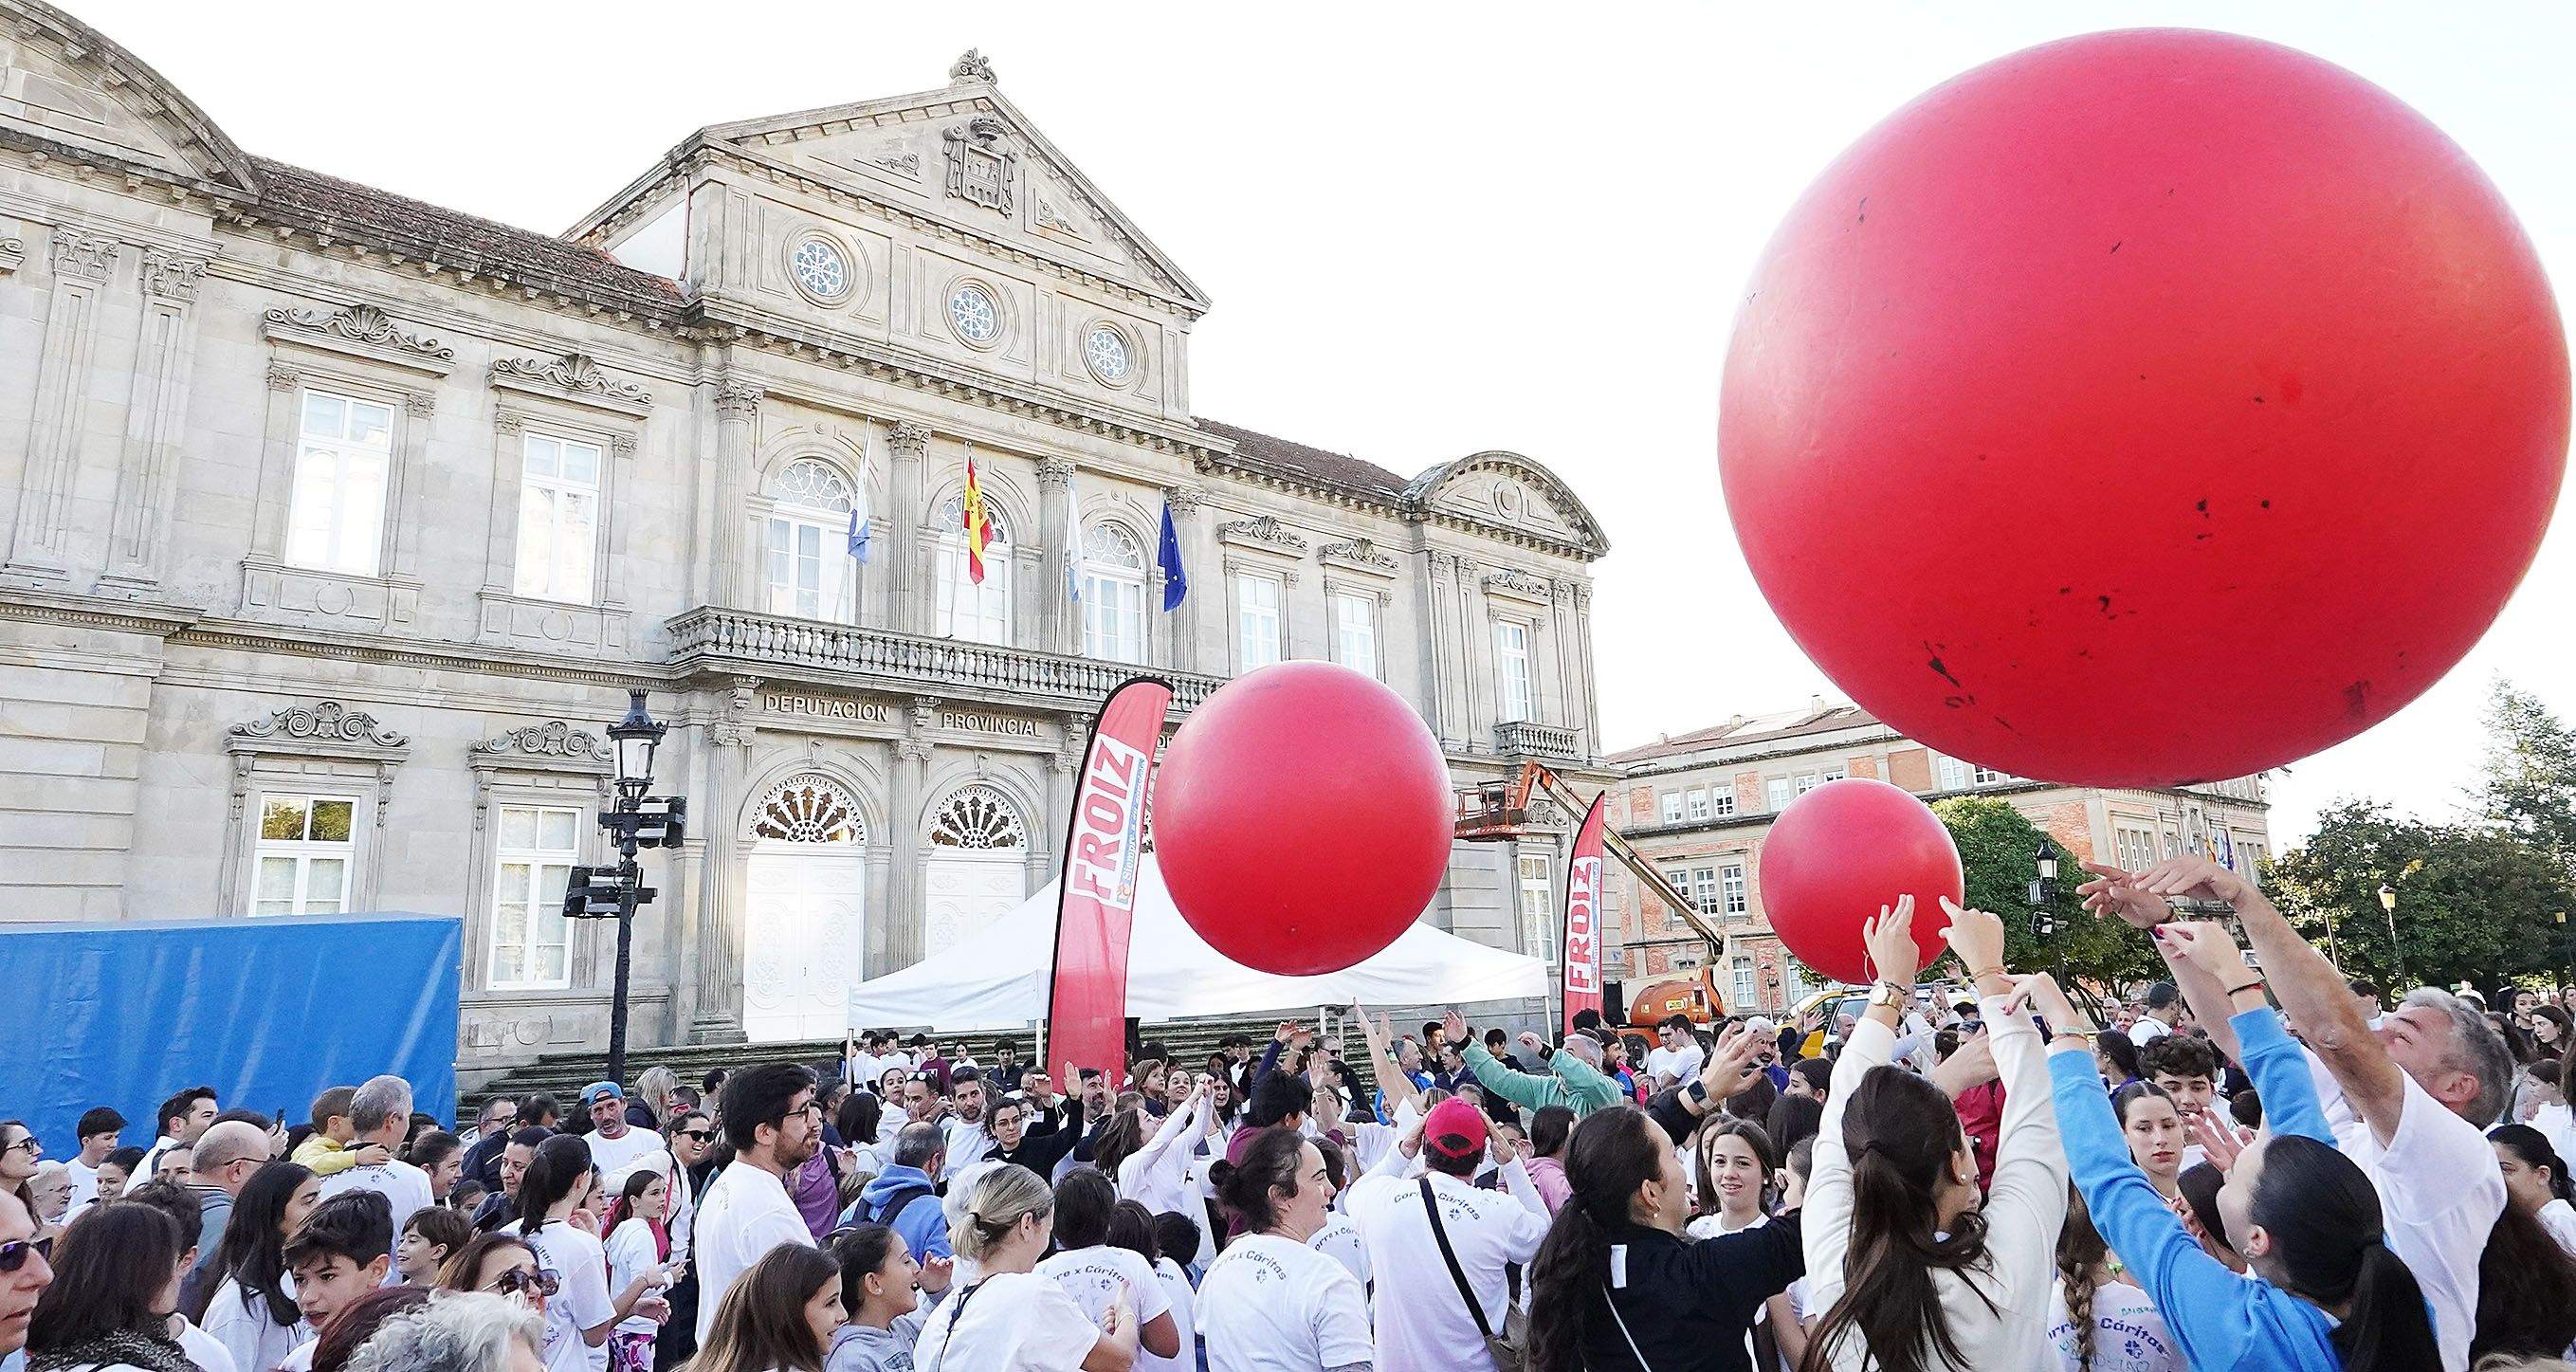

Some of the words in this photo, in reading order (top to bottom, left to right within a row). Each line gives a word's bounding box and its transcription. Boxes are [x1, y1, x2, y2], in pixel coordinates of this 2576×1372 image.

[941, 712, 1043, 737] PROVINCIAL
[1073, 740, 1134, 900] FROIZ
[1568, 862, 1592, 988] FROIZ
[1438, 1192, 1480, 1220] Cáritas
[1315, 1233, 1333, 1251] orre
[1085, 1264, 1124, 1282] Cárita
[1246, 1250, 1287, 1281] Cáritas
[2100, 1317, 2167, 1354] Cáritas
